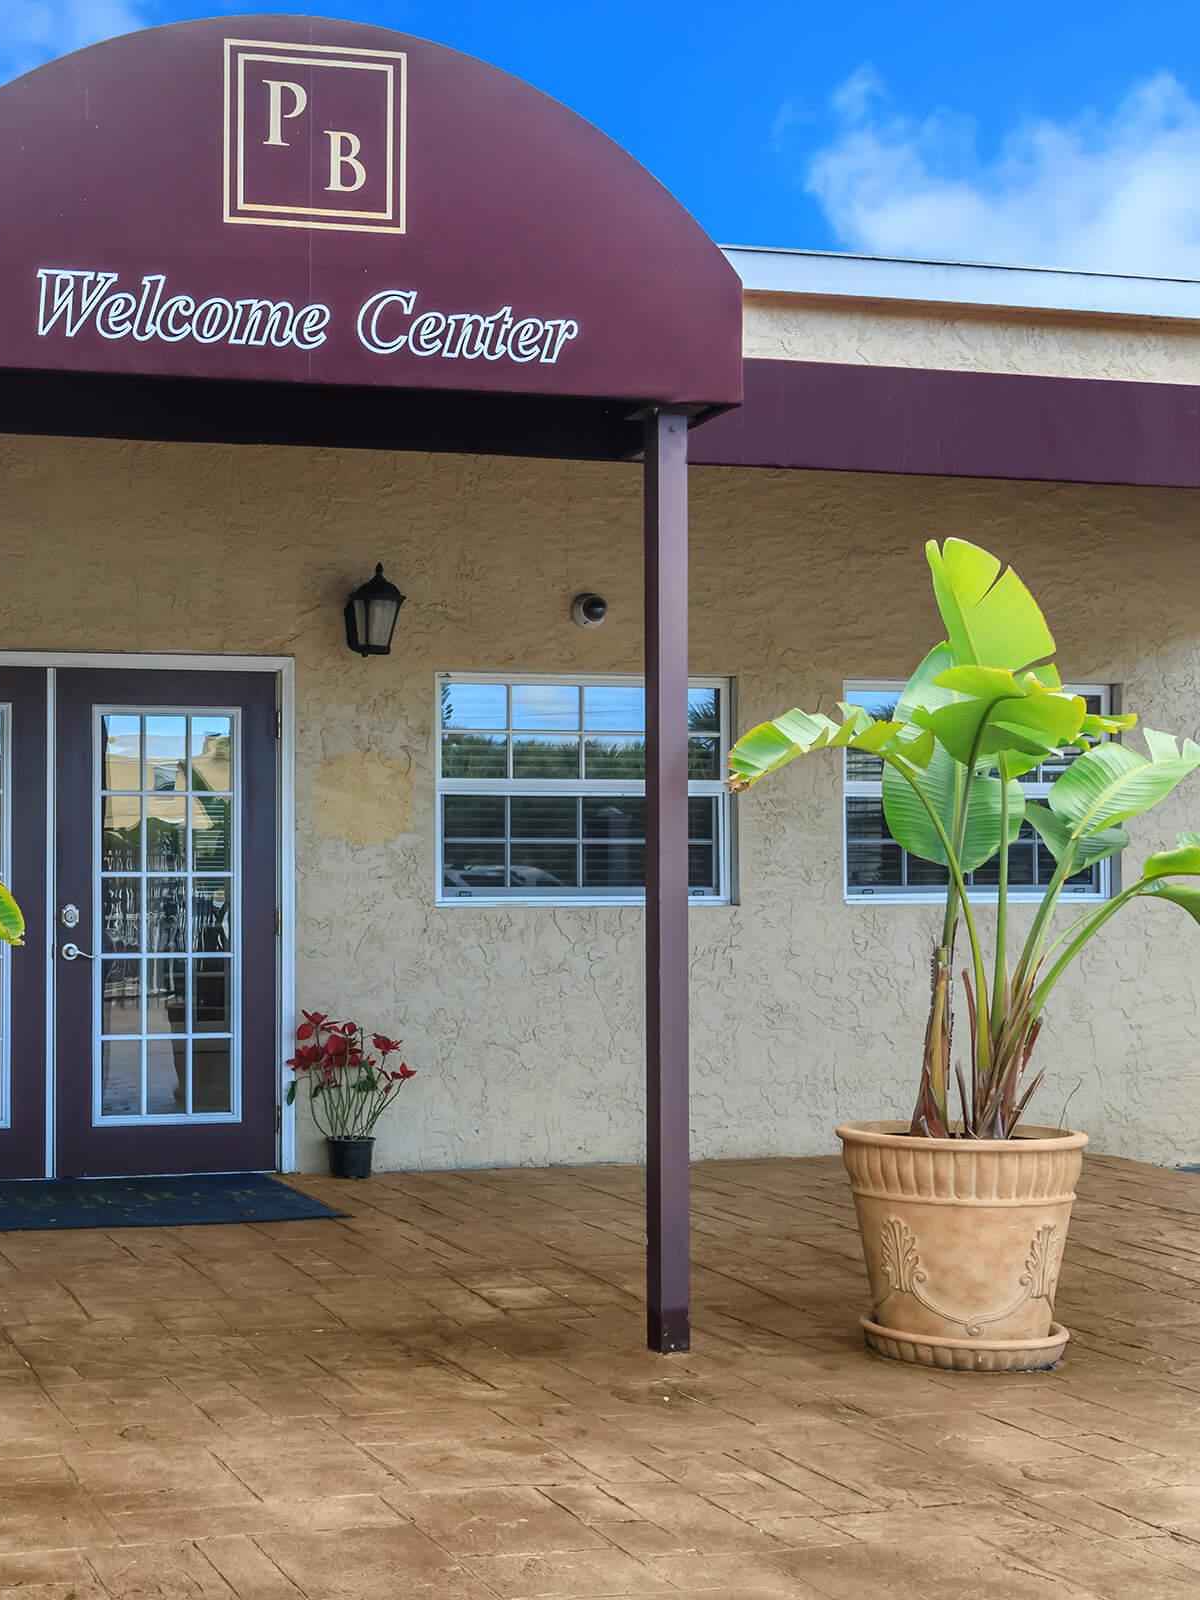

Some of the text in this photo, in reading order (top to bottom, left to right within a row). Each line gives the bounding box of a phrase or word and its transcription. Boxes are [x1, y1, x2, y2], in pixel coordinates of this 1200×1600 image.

[263, 80, 307, 146] P
[324, 131, 366, 191] B
[37, 269, 578, 363] Welcome Center
